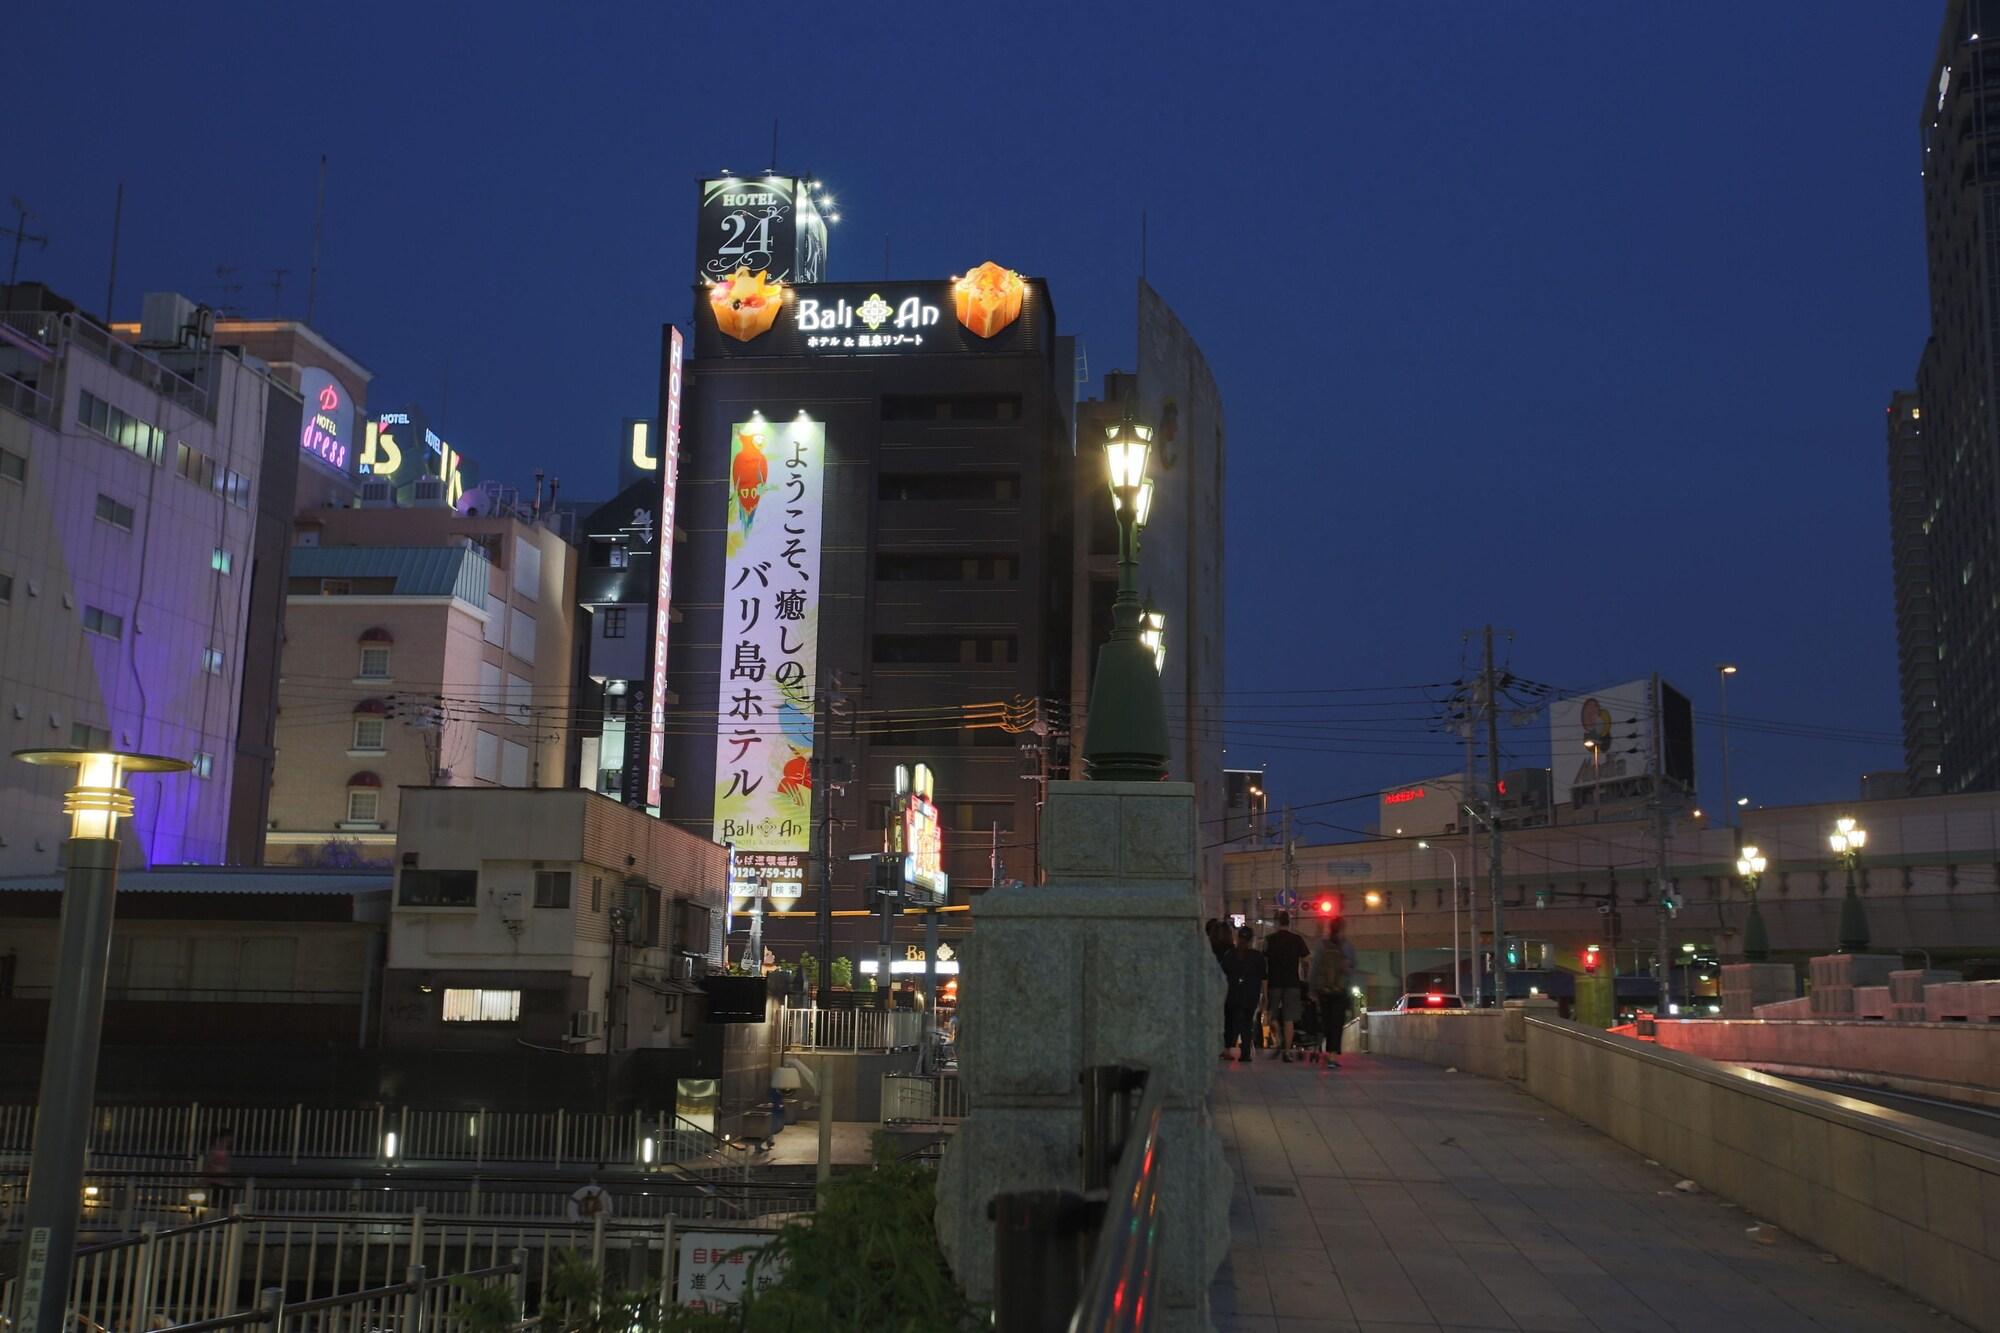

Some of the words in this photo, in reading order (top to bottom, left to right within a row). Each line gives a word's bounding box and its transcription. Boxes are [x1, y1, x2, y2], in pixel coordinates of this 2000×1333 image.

[722, 193, 777, 206] HOTEL
[718, 211, 776, 256] 24
[795, 299, 852, 330] Bali
[893, 297, 940, 329] An
[808, 335, 841, 347] ホテル
[843, 337, 855, 347] &
[316, 413, 337, 436] HOTEL
[380, 413, 410, 424] HOTEL
[667, 341, 681, 490] HOTEL
[303, 416, 346, 467] dress
[425, 427, 442, 455] HOTEL
[775, 440, 810, 687] ようこそ、癒しの
[724, 562, 771, 799] バリ島ホテル
[651, 611, 667, 790] RESORT
[722, 819, 754, 837] Bali
[778, 819, 802, 837] An
[735, 855, 798, 866] んば道頓堀店
[905, 944, 926, 961] Ba
